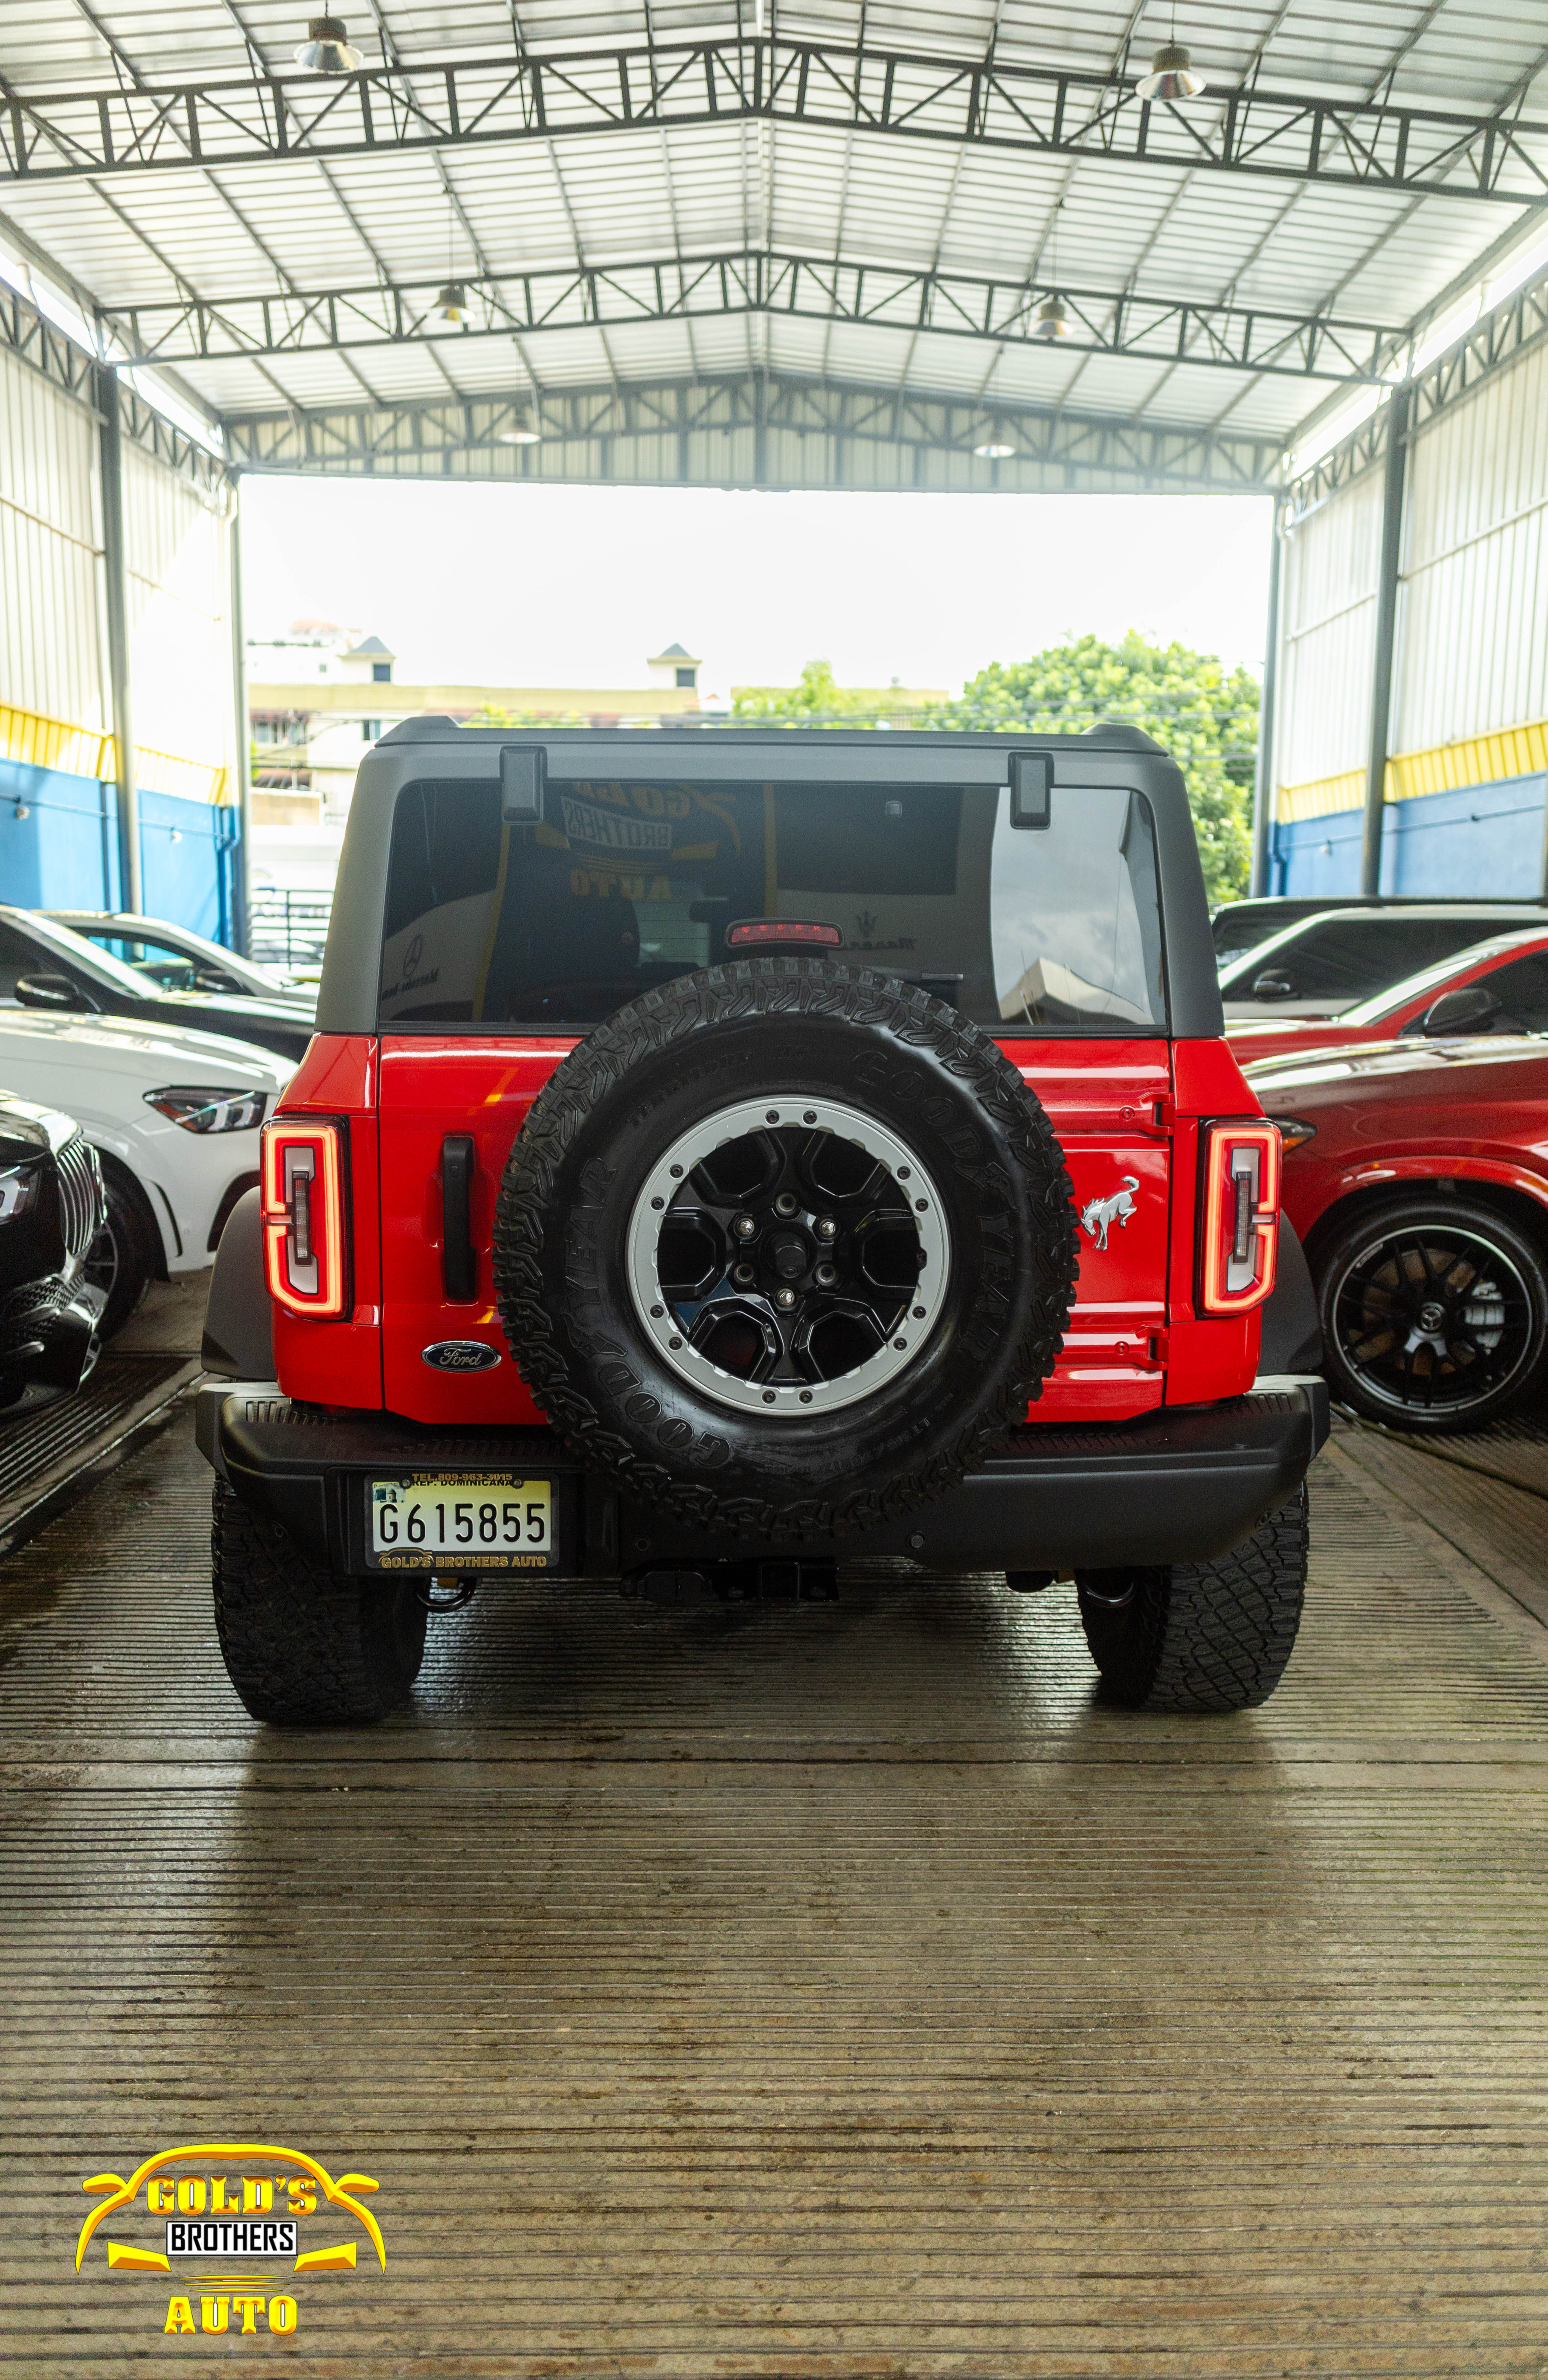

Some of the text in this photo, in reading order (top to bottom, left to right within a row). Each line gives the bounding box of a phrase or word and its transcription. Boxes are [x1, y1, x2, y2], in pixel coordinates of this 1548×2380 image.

[439, 1348, 482, 1365] Ford
[380, 1503, 545, 1543] G615855
[381, 1557, 547, 1568] GOLD'S BROTHERS AUTO
